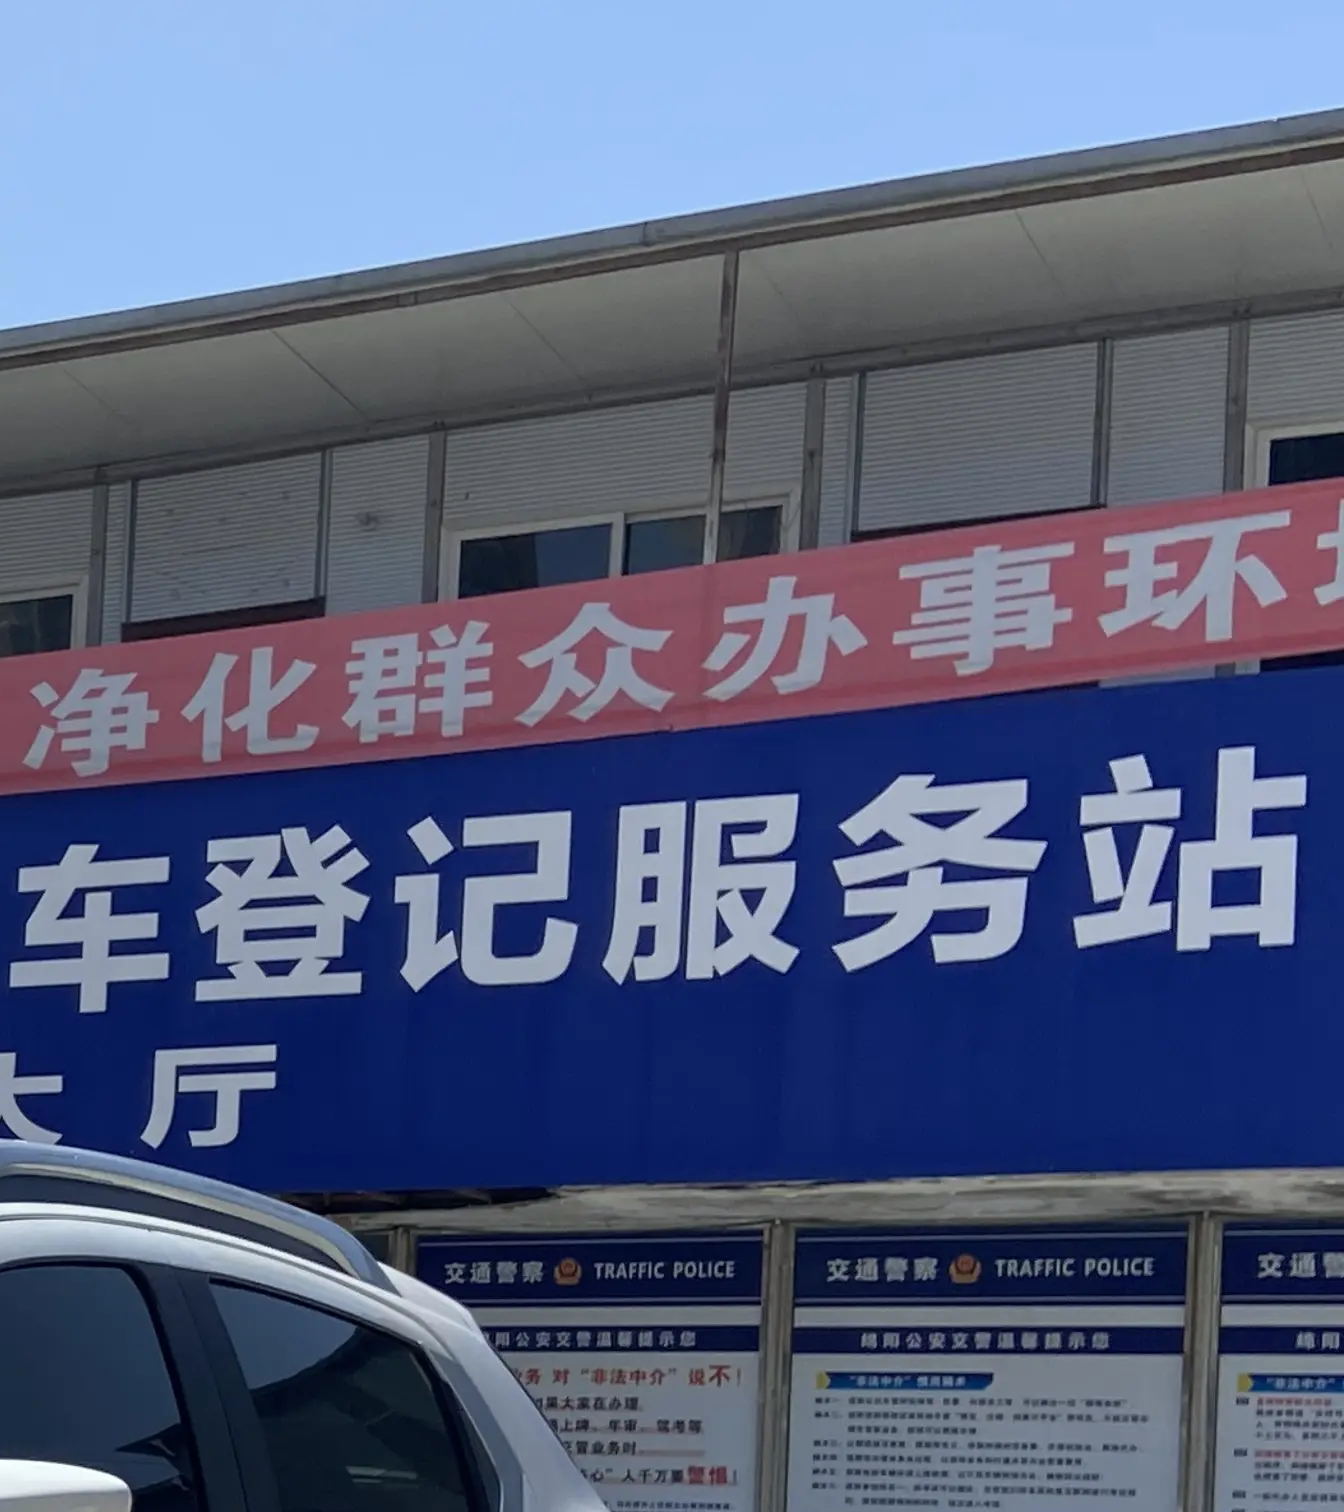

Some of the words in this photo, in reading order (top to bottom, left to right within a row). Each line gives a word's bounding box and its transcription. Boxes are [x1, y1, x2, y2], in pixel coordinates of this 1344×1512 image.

[444, 1260, 545, 1285] 交通警察
[593, 1262, 665, 1280] TRAFFIC
[673, 1260, 736, 1279] POLICE
[826, 1256, 940, 1284] 交通警察
[995, 1257, 1075, 1279] TRAFFIC
[1084, 1256, 1155, 1277] POLICE
